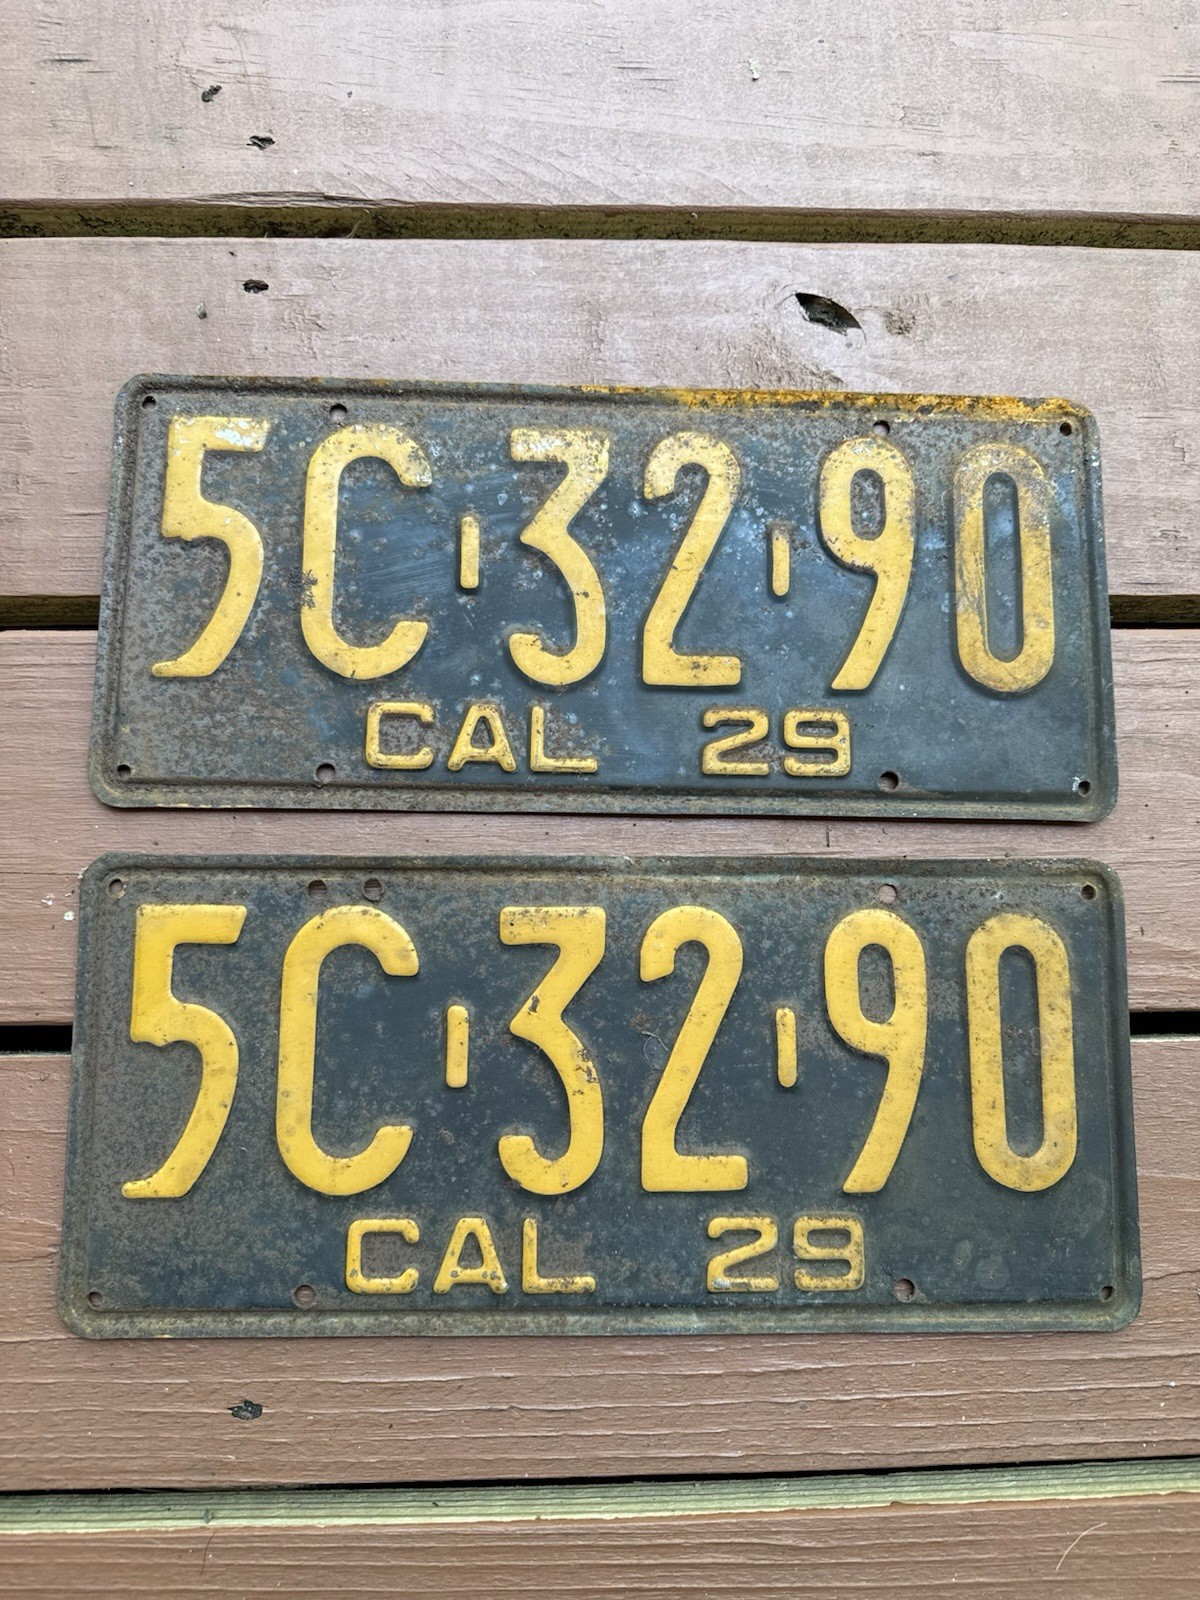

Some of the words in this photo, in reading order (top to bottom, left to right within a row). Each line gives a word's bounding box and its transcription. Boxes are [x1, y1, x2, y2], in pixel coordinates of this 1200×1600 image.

[364, 700, 598, 774] CAL
[701, 708, 852, 777] 29
[345, 1216, 597, 1294] CAL
[706, 1215, 866, 1293] 29
